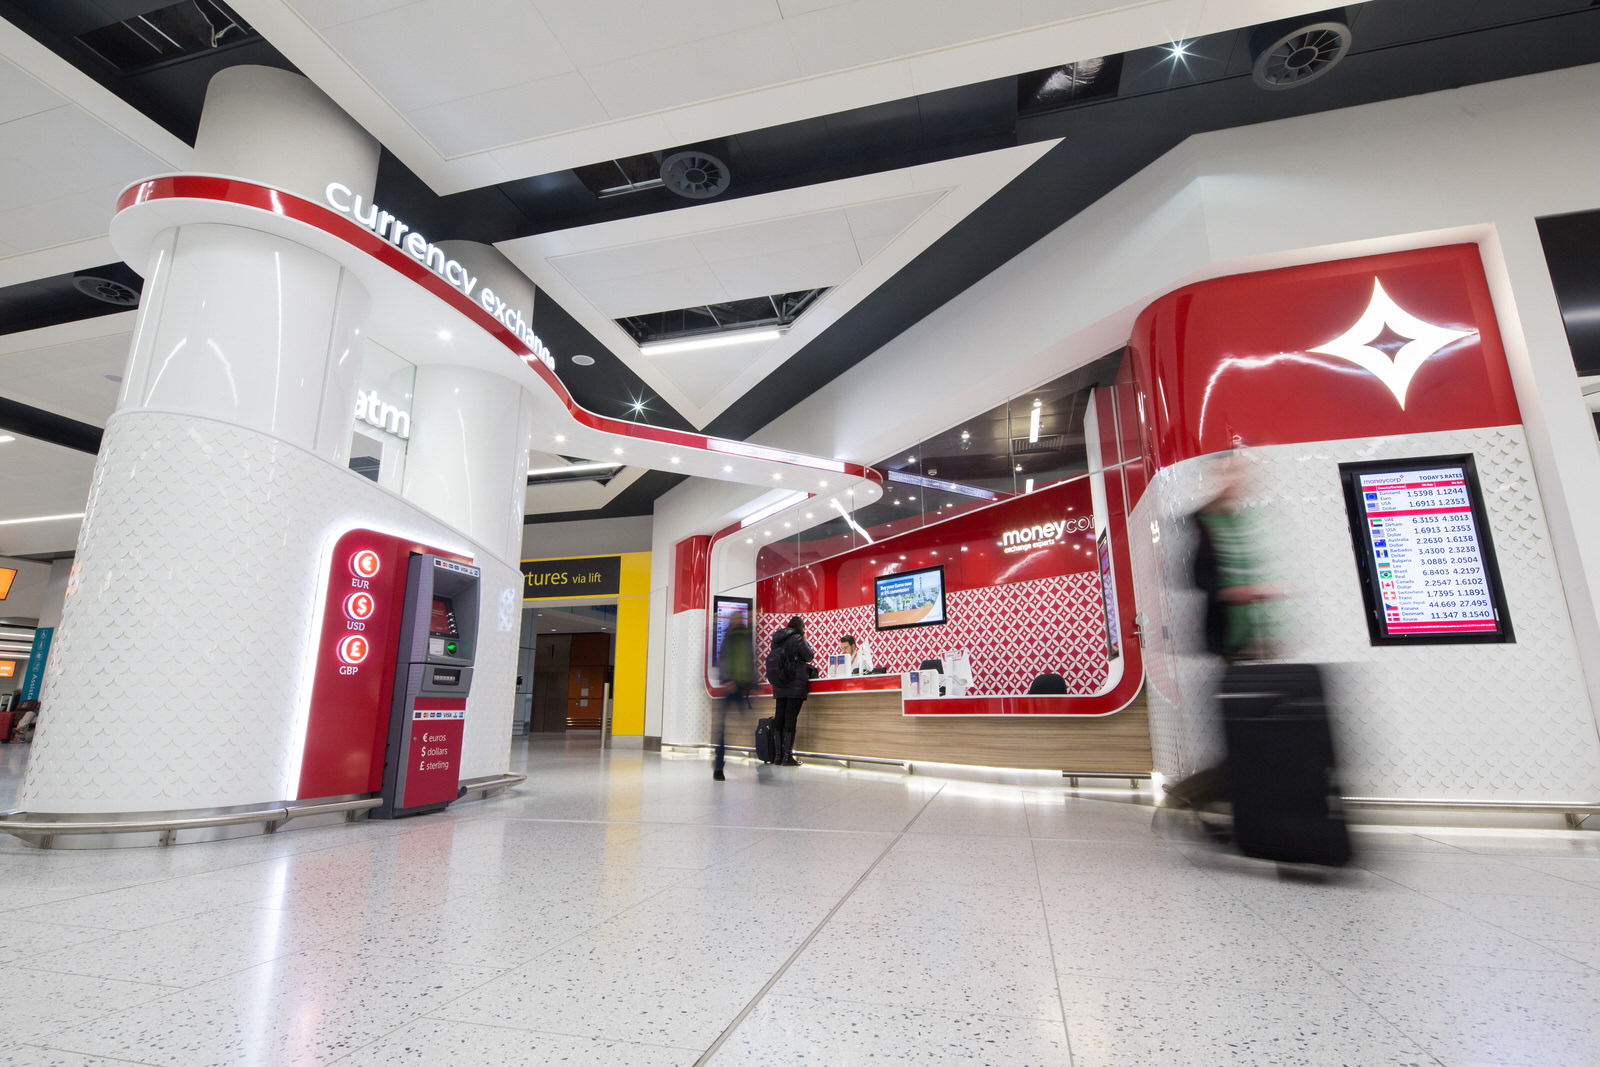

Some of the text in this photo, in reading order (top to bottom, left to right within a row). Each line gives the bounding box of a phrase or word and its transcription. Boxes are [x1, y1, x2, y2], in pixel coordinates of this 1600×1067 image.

[326, 182, 556, 371] currency exchange
[355, 389, 410, 439] atm
[1004, 539, 1055, 553] exchange experts
[362, 556, 373, 571] €
[572, 574, 586, 583] via
[589, 572, 602, 583] lift
[351, 578, 369, 589] EUR
[357, 597, 367, 615] $
[346, 621, 365, 631] USD
[350, 641, 361, 656] £
[339, 666, 358, 675] GBP
[423, 733, 428, 742] €
[421, 746, 447, 757] $ dollars
[420, 761, 449, 770] £ sterling
